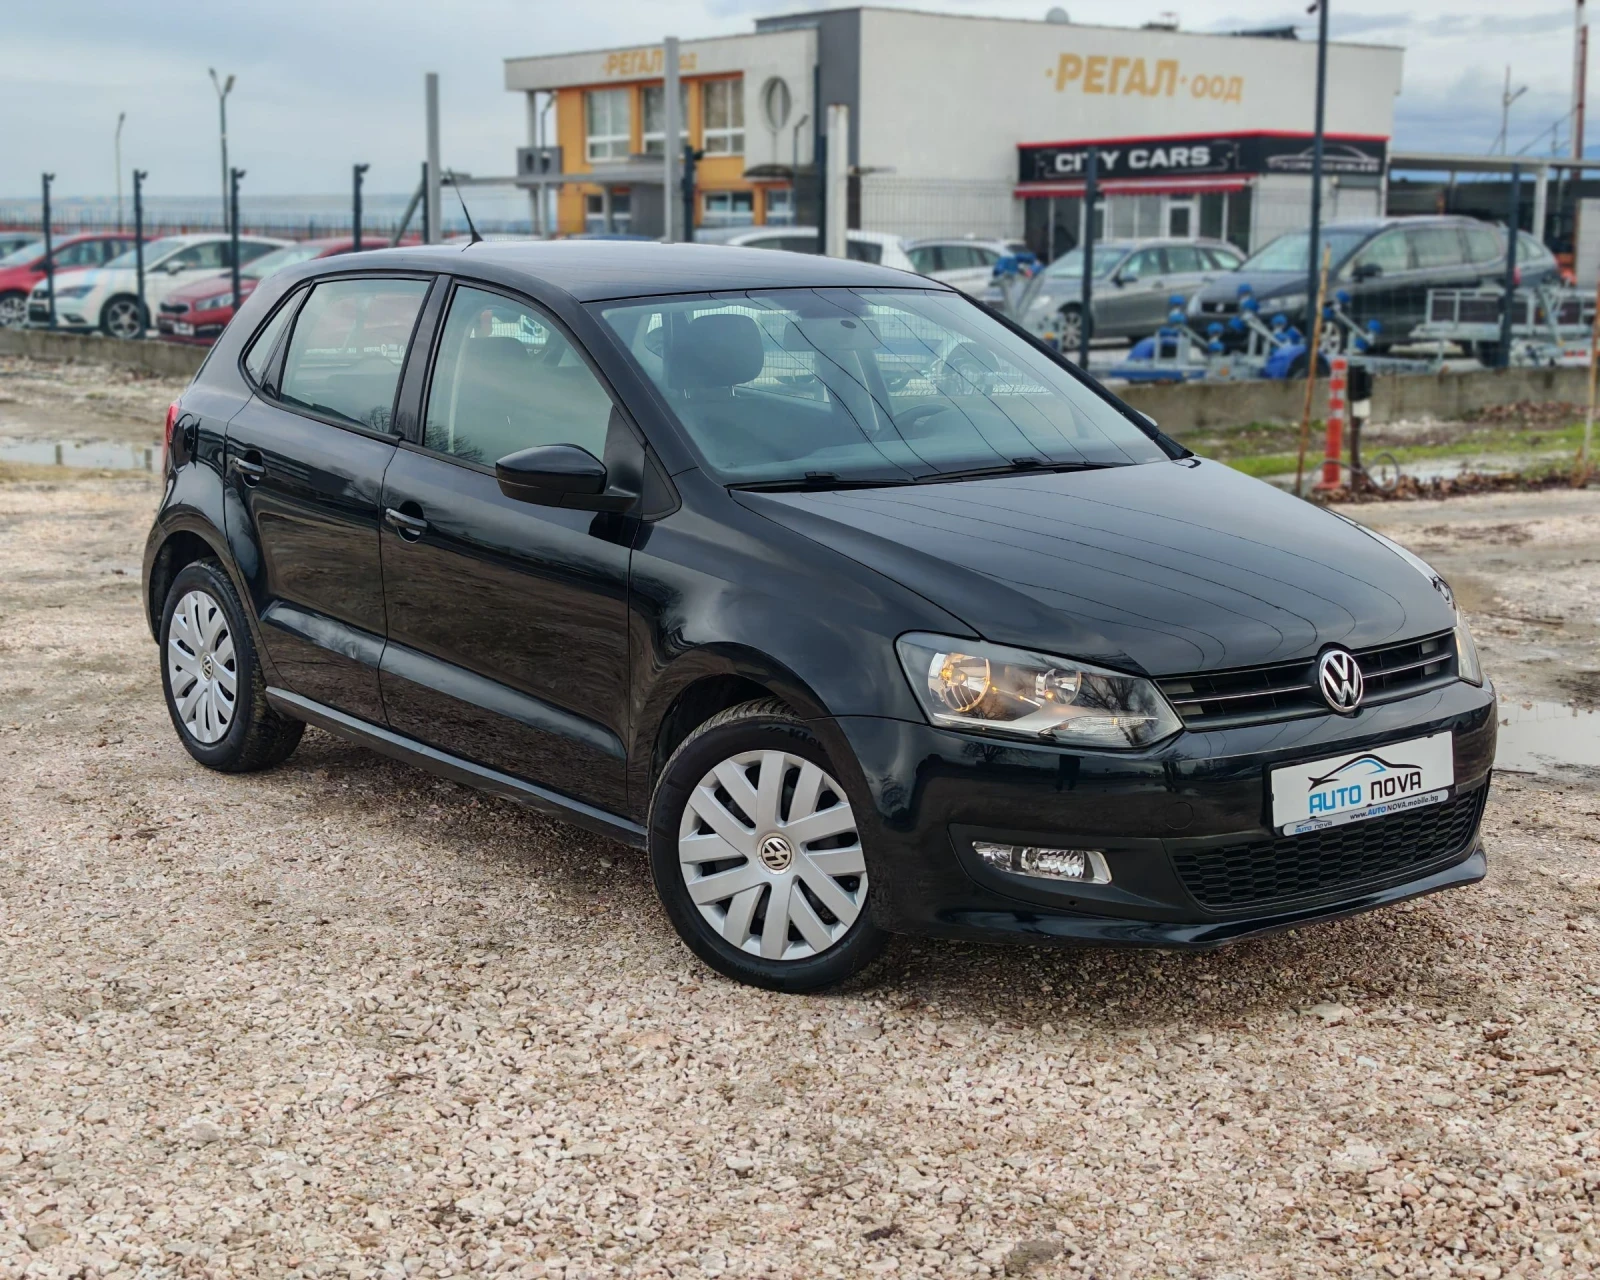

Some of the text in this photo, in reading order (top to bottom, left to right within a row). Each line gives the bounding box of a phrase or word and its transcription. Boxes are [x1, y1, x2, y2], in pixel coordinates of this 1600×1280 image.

[1128, 146, 1210, 169] CARS
[1308, 771, 1422, 814] AUTO NOVA
